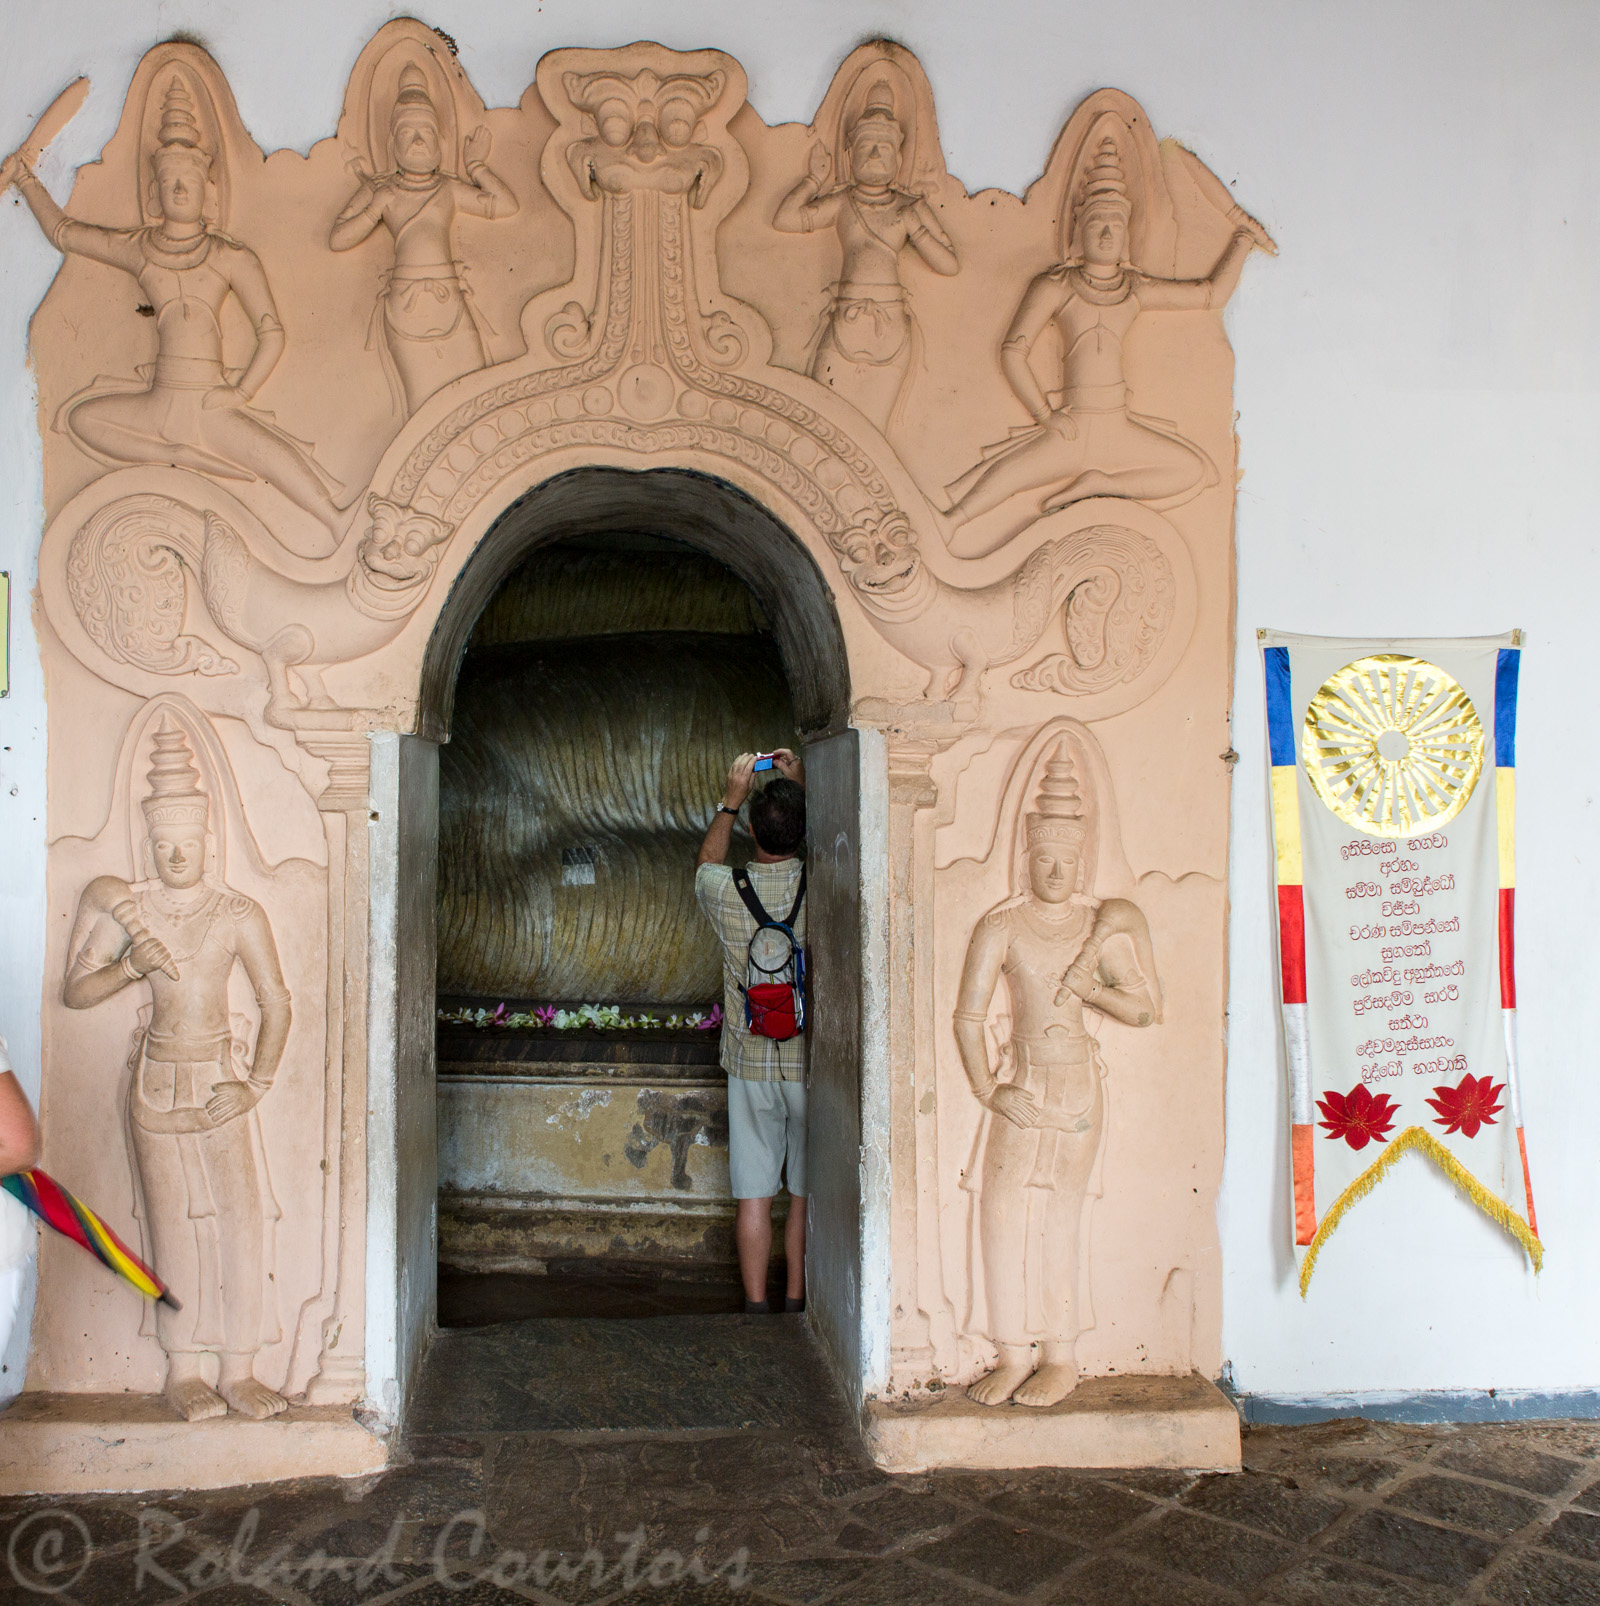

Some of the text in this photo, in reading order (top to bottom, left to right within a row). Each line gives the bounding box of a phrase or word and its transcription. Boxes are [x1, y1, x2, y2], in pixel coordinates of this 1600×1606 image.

[1340, 833, 1448, 861] ඉතිපිසො භගවා
[1379, 857, 1419, 878] අරහං
[1345, 874, 1455, 899] සම්මා සම්බුද්ධෝ
[1381, 901, 1420, 917] විජ්ජා
[1349, 916, 1460, 941] චරණ සම්පන්නෝ
[1380, 940, 1432, 963] සුගතෝ
[1404, 960, 1465, 984] අනුත්තරෝ
[1353, 990, 1414, 1015] පුරිසදම්ම
[1388, 1014, 1428, 1030] සත්ථා
[1355, 1036, 1454, 1058] දේවමනුස්සානං
[1361, 1054, 1467, 1084] බුද්ධෝ භගවාති
